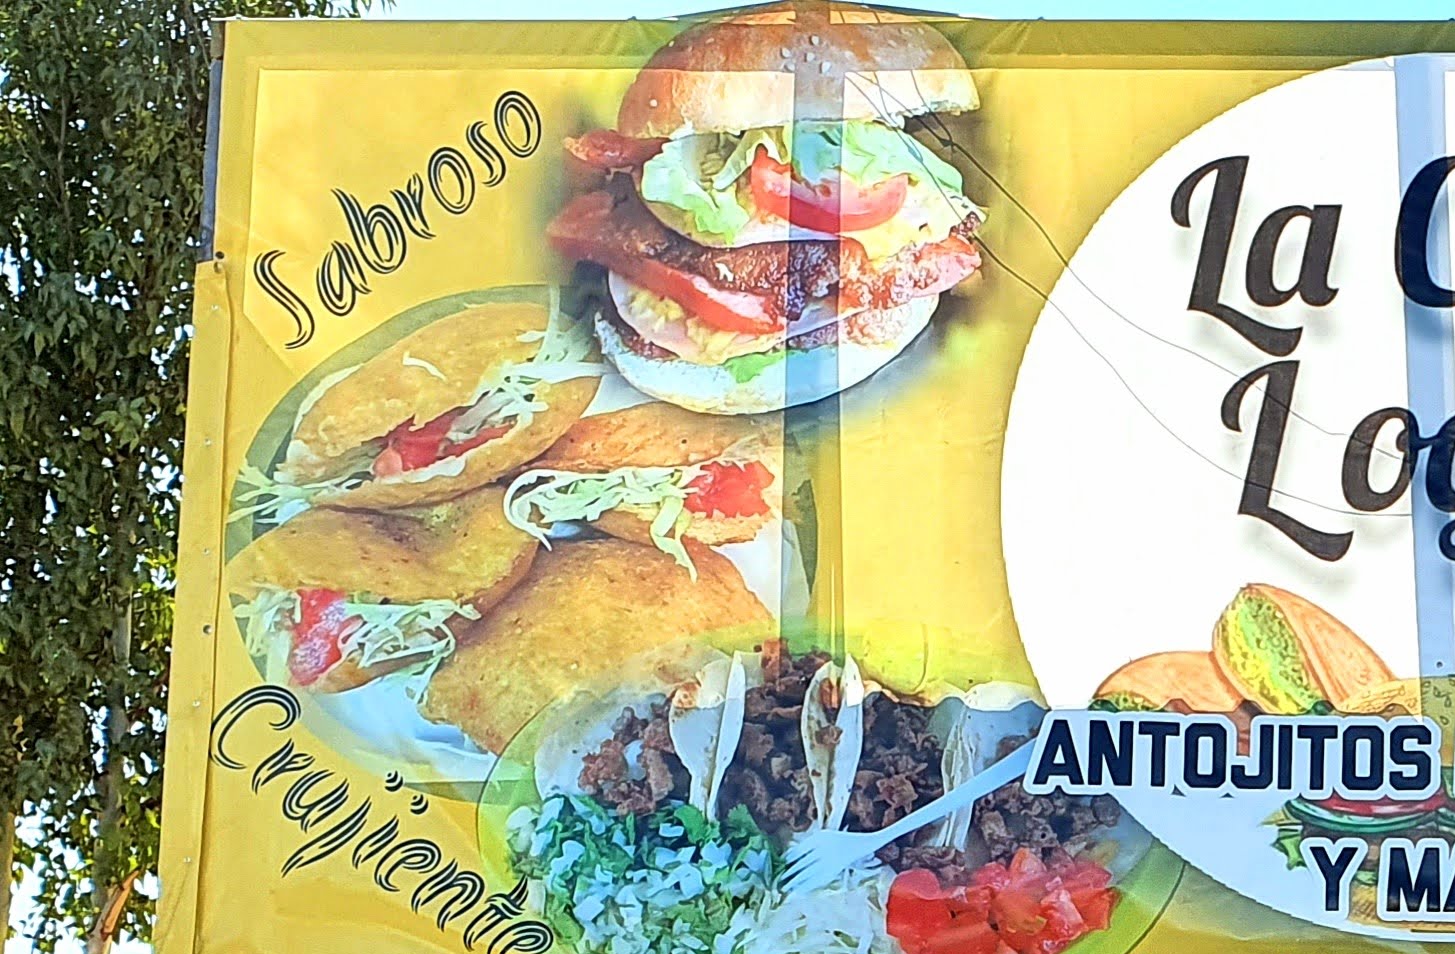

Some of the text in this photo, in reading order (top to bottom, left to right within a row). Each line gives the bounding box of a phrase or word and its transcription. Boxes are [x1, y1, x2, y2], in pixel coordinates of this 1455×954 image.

[254, 91, 541, 349] Sabroso
[1171, 155, 1342, 357] La
[1034, 719, 1432, 793] ANTOJITOS
[1309, 846, 1361, 912] Y
